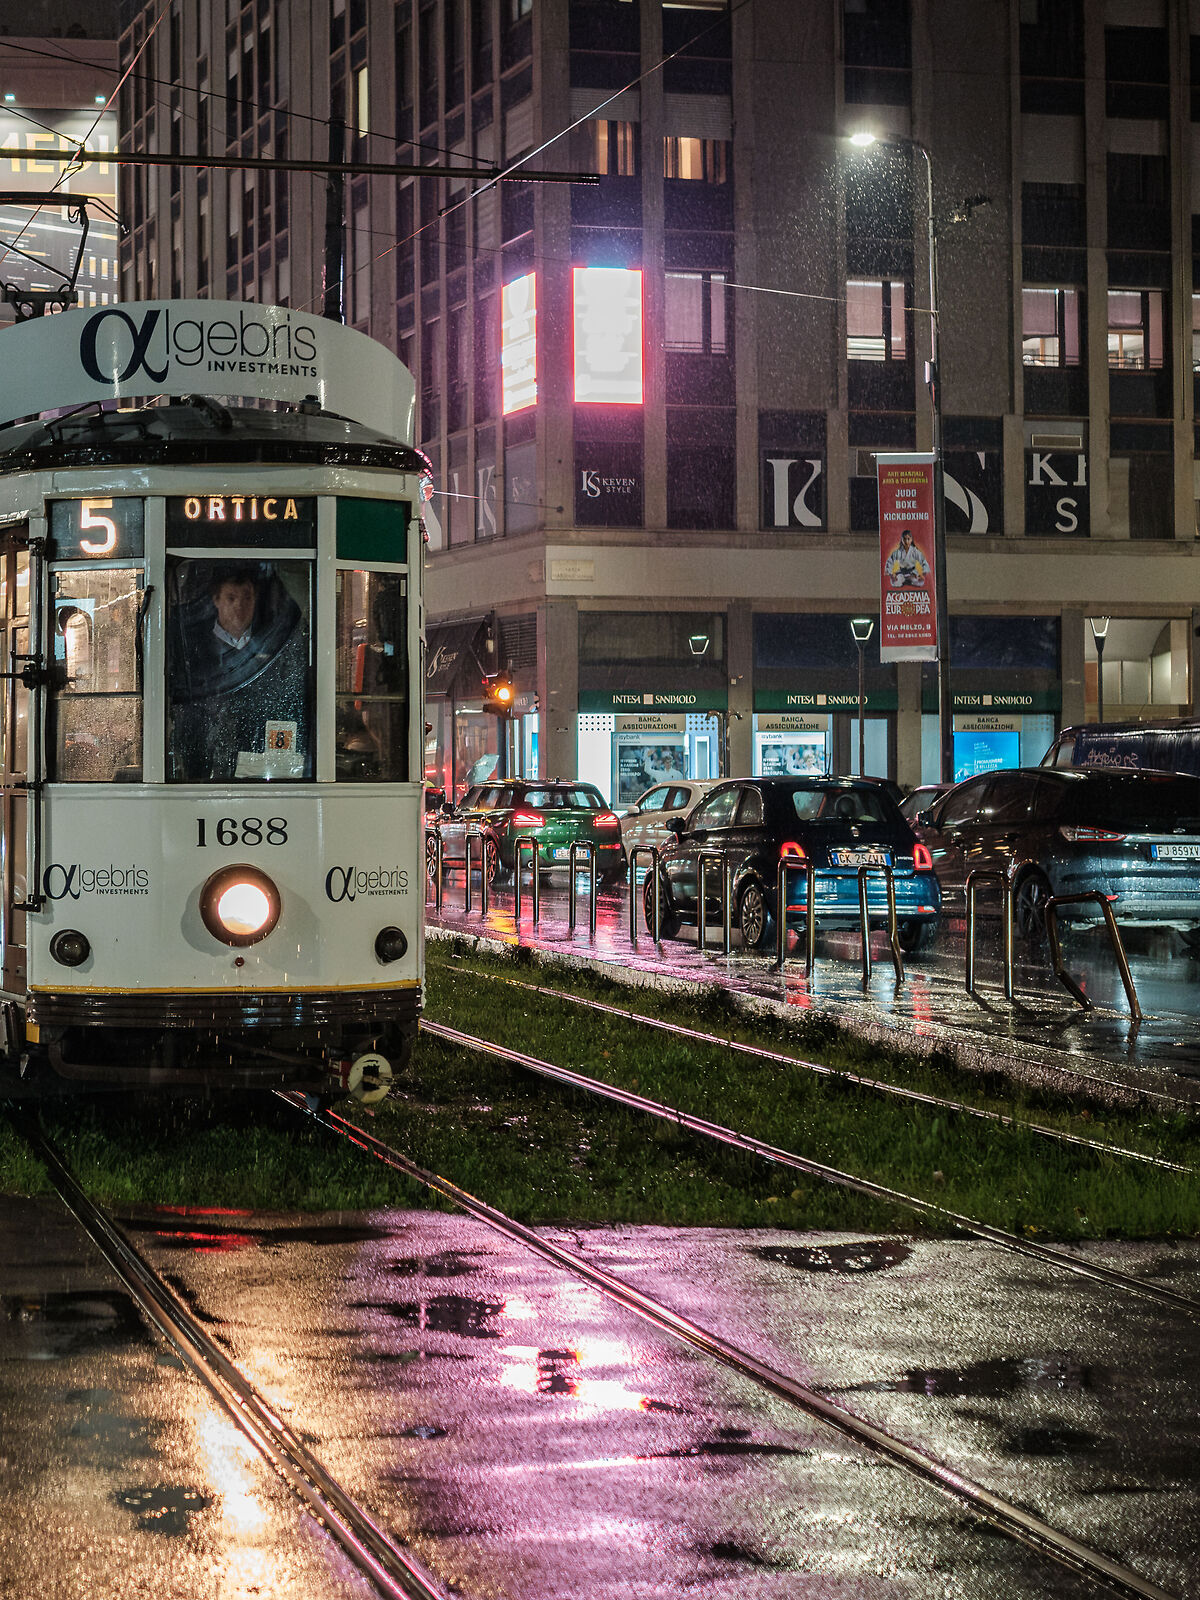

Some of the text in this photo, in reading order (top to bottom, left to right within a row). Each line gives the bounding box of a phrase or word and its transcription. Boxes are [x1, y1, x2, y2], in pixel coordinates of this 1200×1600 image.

[207, 360, 318, 378] INVESTMENTS
[602, 477, 636, 486] KEVEN
[606, 486, 632, 494] STYLE
[895, 488, 917, 498] JUDO
[183, 497, 299, 520] ORTICA
[895, 500, 917, 509] BOXE
[883, 512, 930, 521] KICKBOXING
[79, 498, 117, 554] 5
[885, 591, 931, 602] ACCADEMIA
[612, 694, 641, 704] INTESA
[787, 695, 815, 705] INTESA
[954, 695, 980, 705] INTESA
[196, 817, 289, 847] 1688
[1157, 846, 1170, 856] FJ
[367, 888, 409, 897] INVESTMENTS
